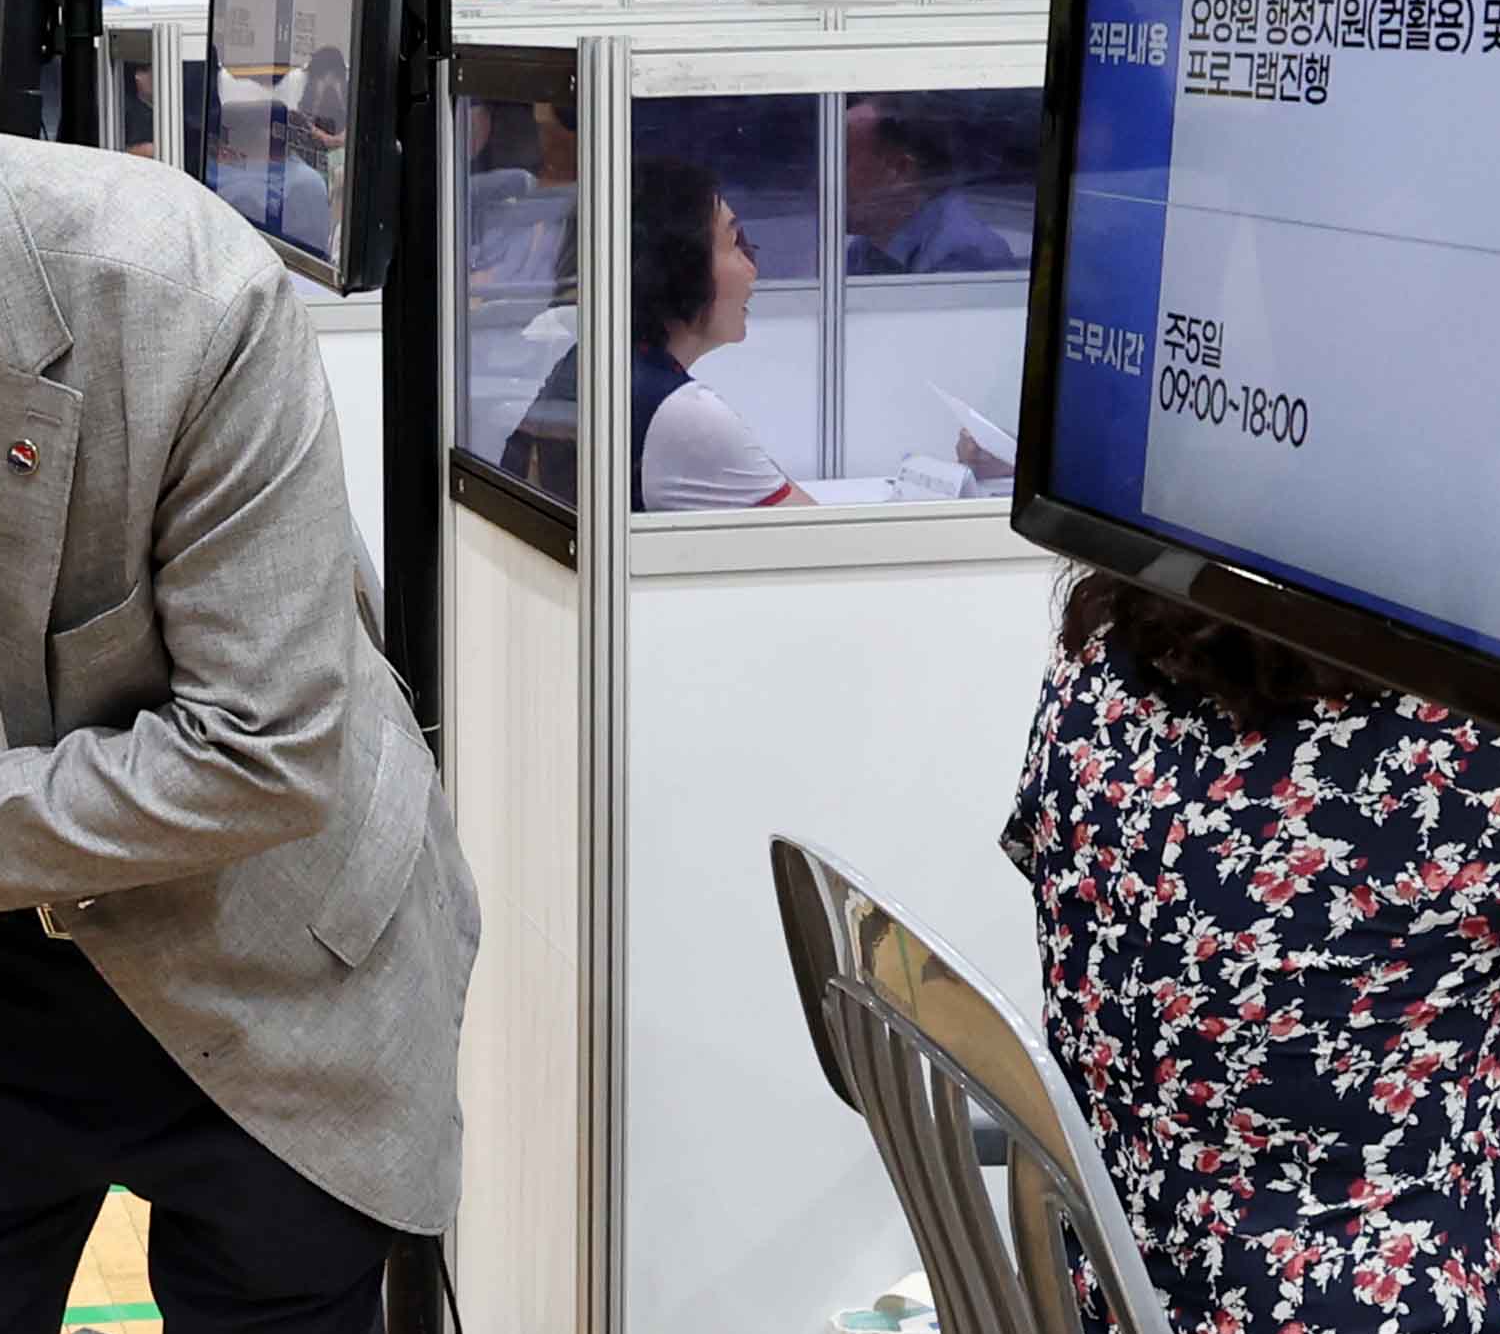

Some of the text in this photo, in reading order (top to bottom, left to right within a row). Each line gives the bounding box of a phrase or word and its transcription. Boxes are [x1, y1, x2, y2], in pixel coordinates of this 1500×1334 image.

[1089, 21, 1169, 67] 직무내용
[1184, 51, 1331, 106] 프로그램진행
[1064, 318, 1145, 376] 근무시간
[1163, 312, 1224, 369] 주5일
[1160, 365, 1308, 449] 09:00~18:00
